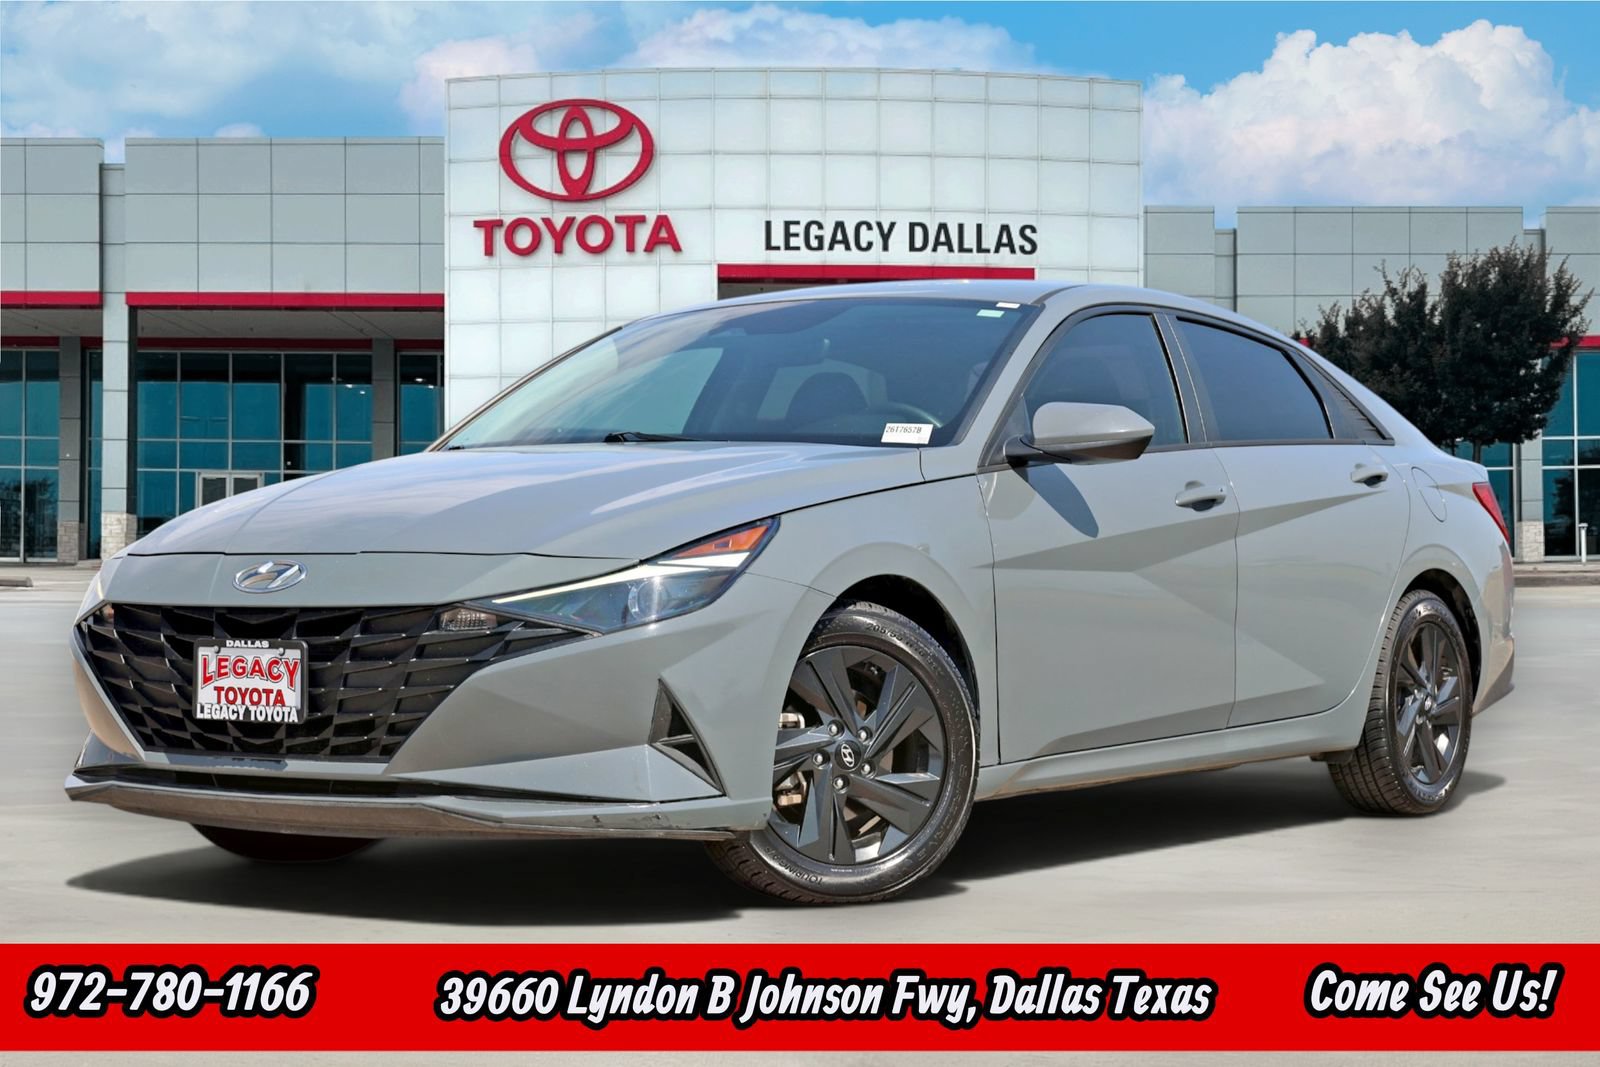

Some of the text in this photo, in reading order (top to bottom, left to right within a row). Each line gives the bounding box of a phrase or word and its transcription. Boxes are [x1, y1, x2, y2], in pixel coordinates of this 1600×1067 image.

[474, 214, 682, 257] TOYOTA
[765, 220, 1038, 255] LEGACY DALLAS
[226, 640, 269, 648] DALLAS
[201, 655, 300, 692] LEGACY
[214, 686, 286, 706] TOYOTA
[196, 703, 298, 723] LEGACY TOYOTA
